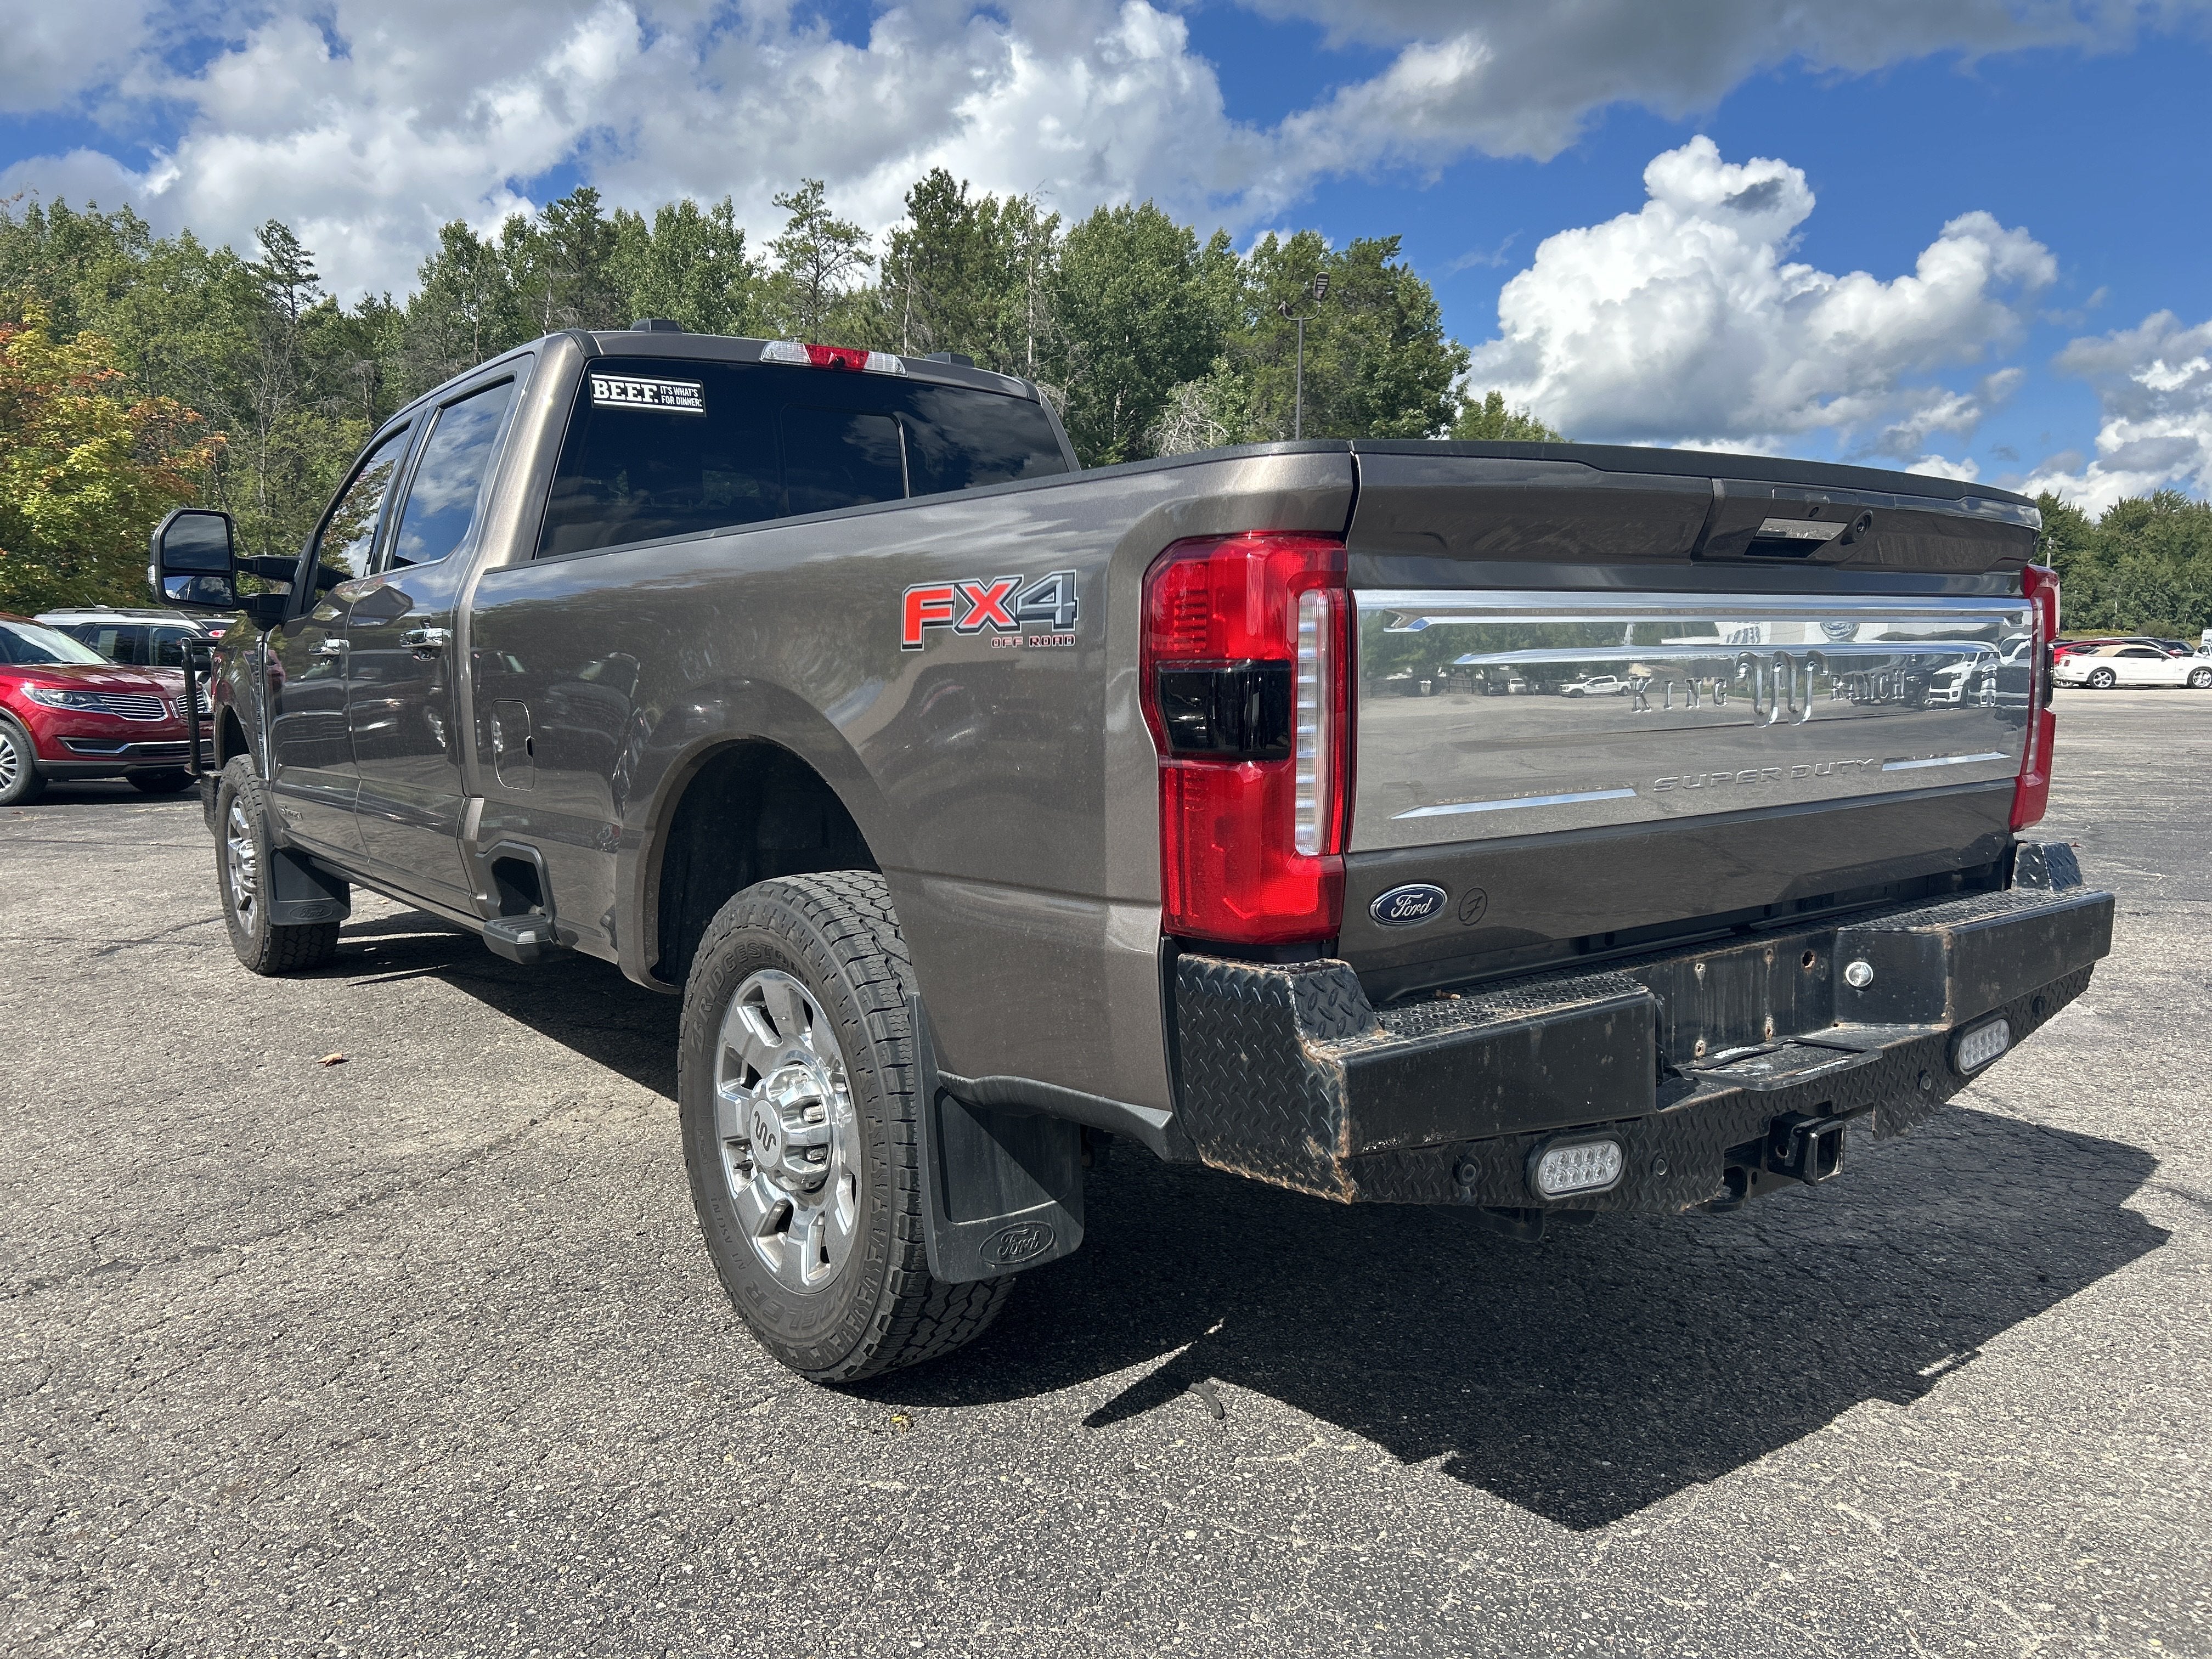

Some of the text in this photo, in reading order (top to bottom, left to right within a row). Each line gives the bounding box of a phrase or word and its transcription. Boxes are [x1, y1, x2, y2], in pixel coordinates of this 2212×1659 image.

[591, 379, 658, 403] BEEF.
[660, 386, 698, 397] IT'S WHAT'S
[661, 395, 675, 404] FOR
[901, 569, 1079, 652] FX4
[991, 634, 1075, 648] OFF ROAD
[1628, 668, 1906, 713] KING RANCH
[1653, 759, 1874, 792] SUPER DUTY
[300, 907, 324, 918] Ford
[1390, 893, 1434, 918] Ford
[997, 1228, 1041, 1258] Ford
